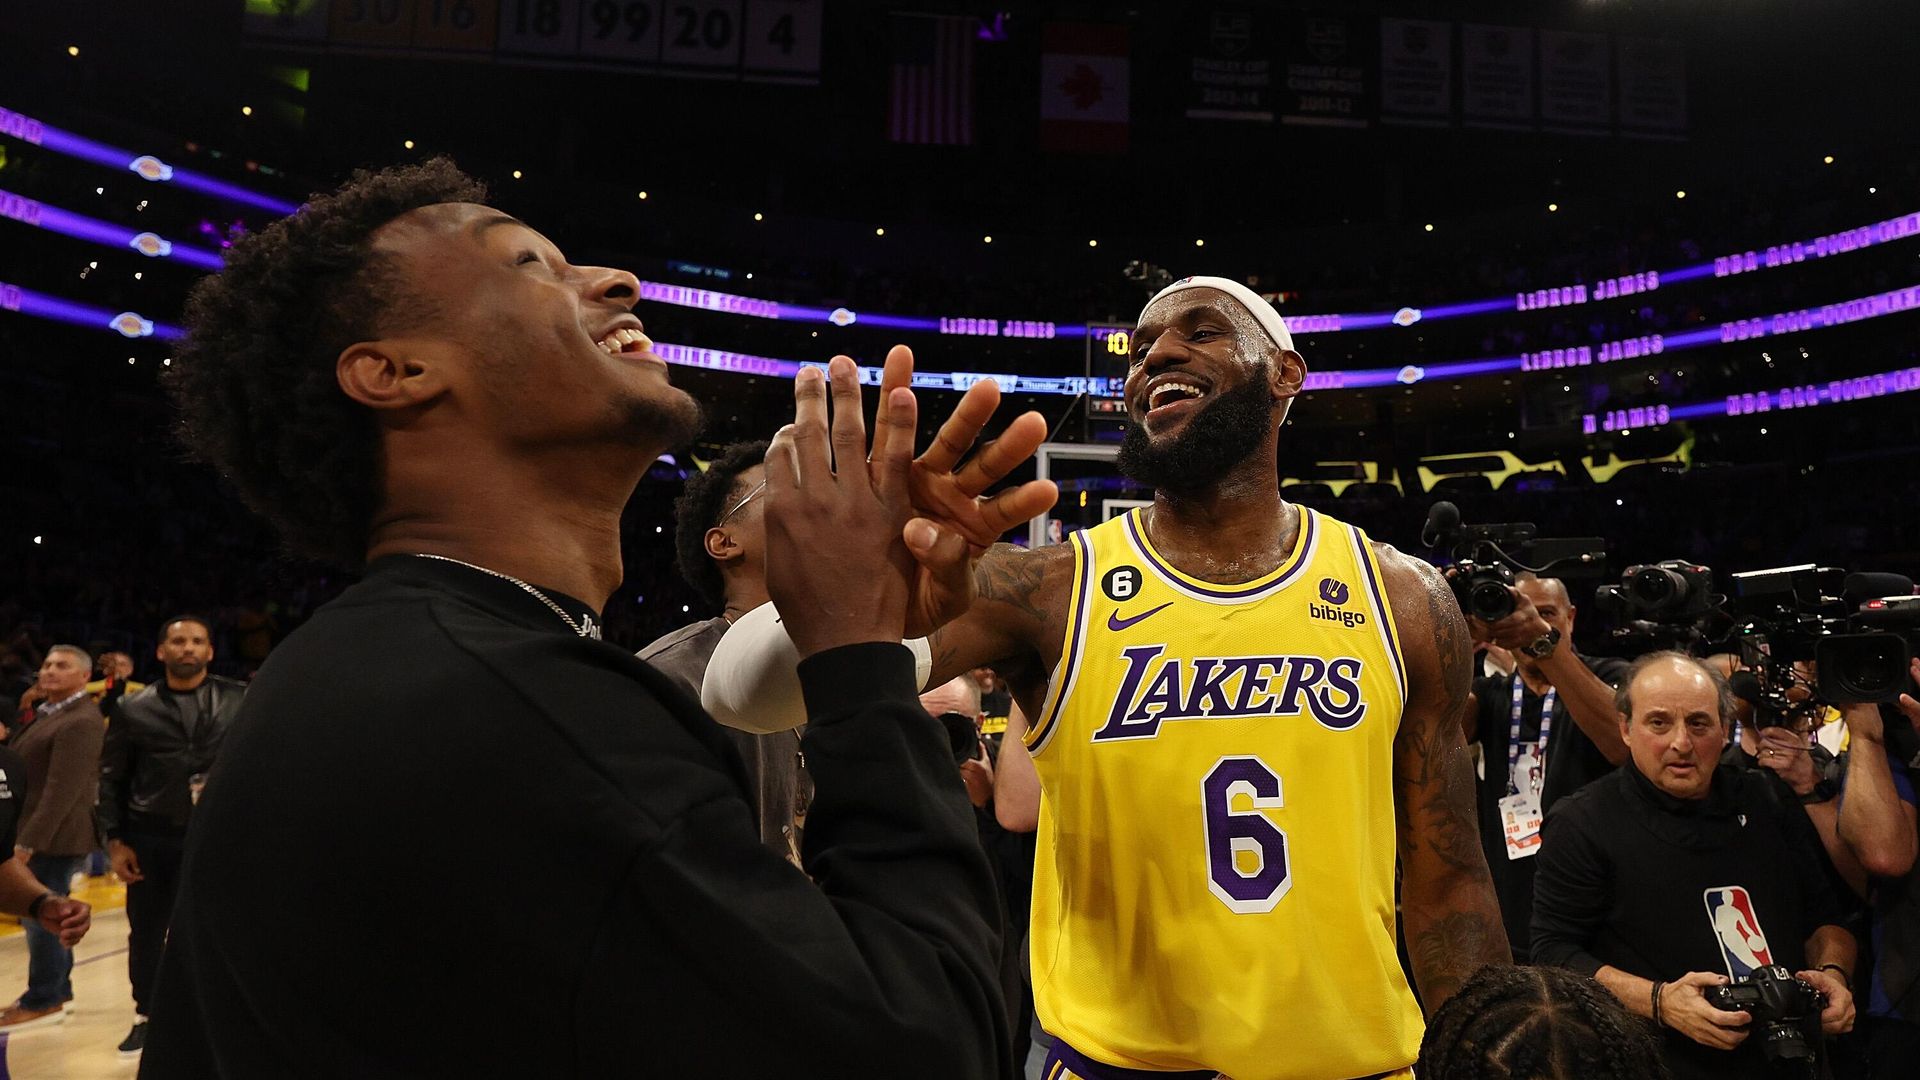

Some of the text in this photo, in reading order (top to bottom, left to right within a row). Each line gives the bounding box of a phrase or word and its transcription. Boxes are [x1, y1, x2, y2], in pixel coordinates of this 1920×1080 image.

[515, 0, 562, 37] 18
[591, 0, 653, 42] 99
[672, 6, 732, 49] 20
[767, 14, 796, 54] 4
[1593, 270, 1660, 301] JAMES
[1597, 334, 1664, 363] JAMES
[1602, 404, 1670, 432] JAMES
[1111, 570, 1133, 597] 6
[1309, 602, 1366, 628] bibigo
[1090, 642, 1368, 744] LAKERS
[1200, 755, 1293, 914] 6
